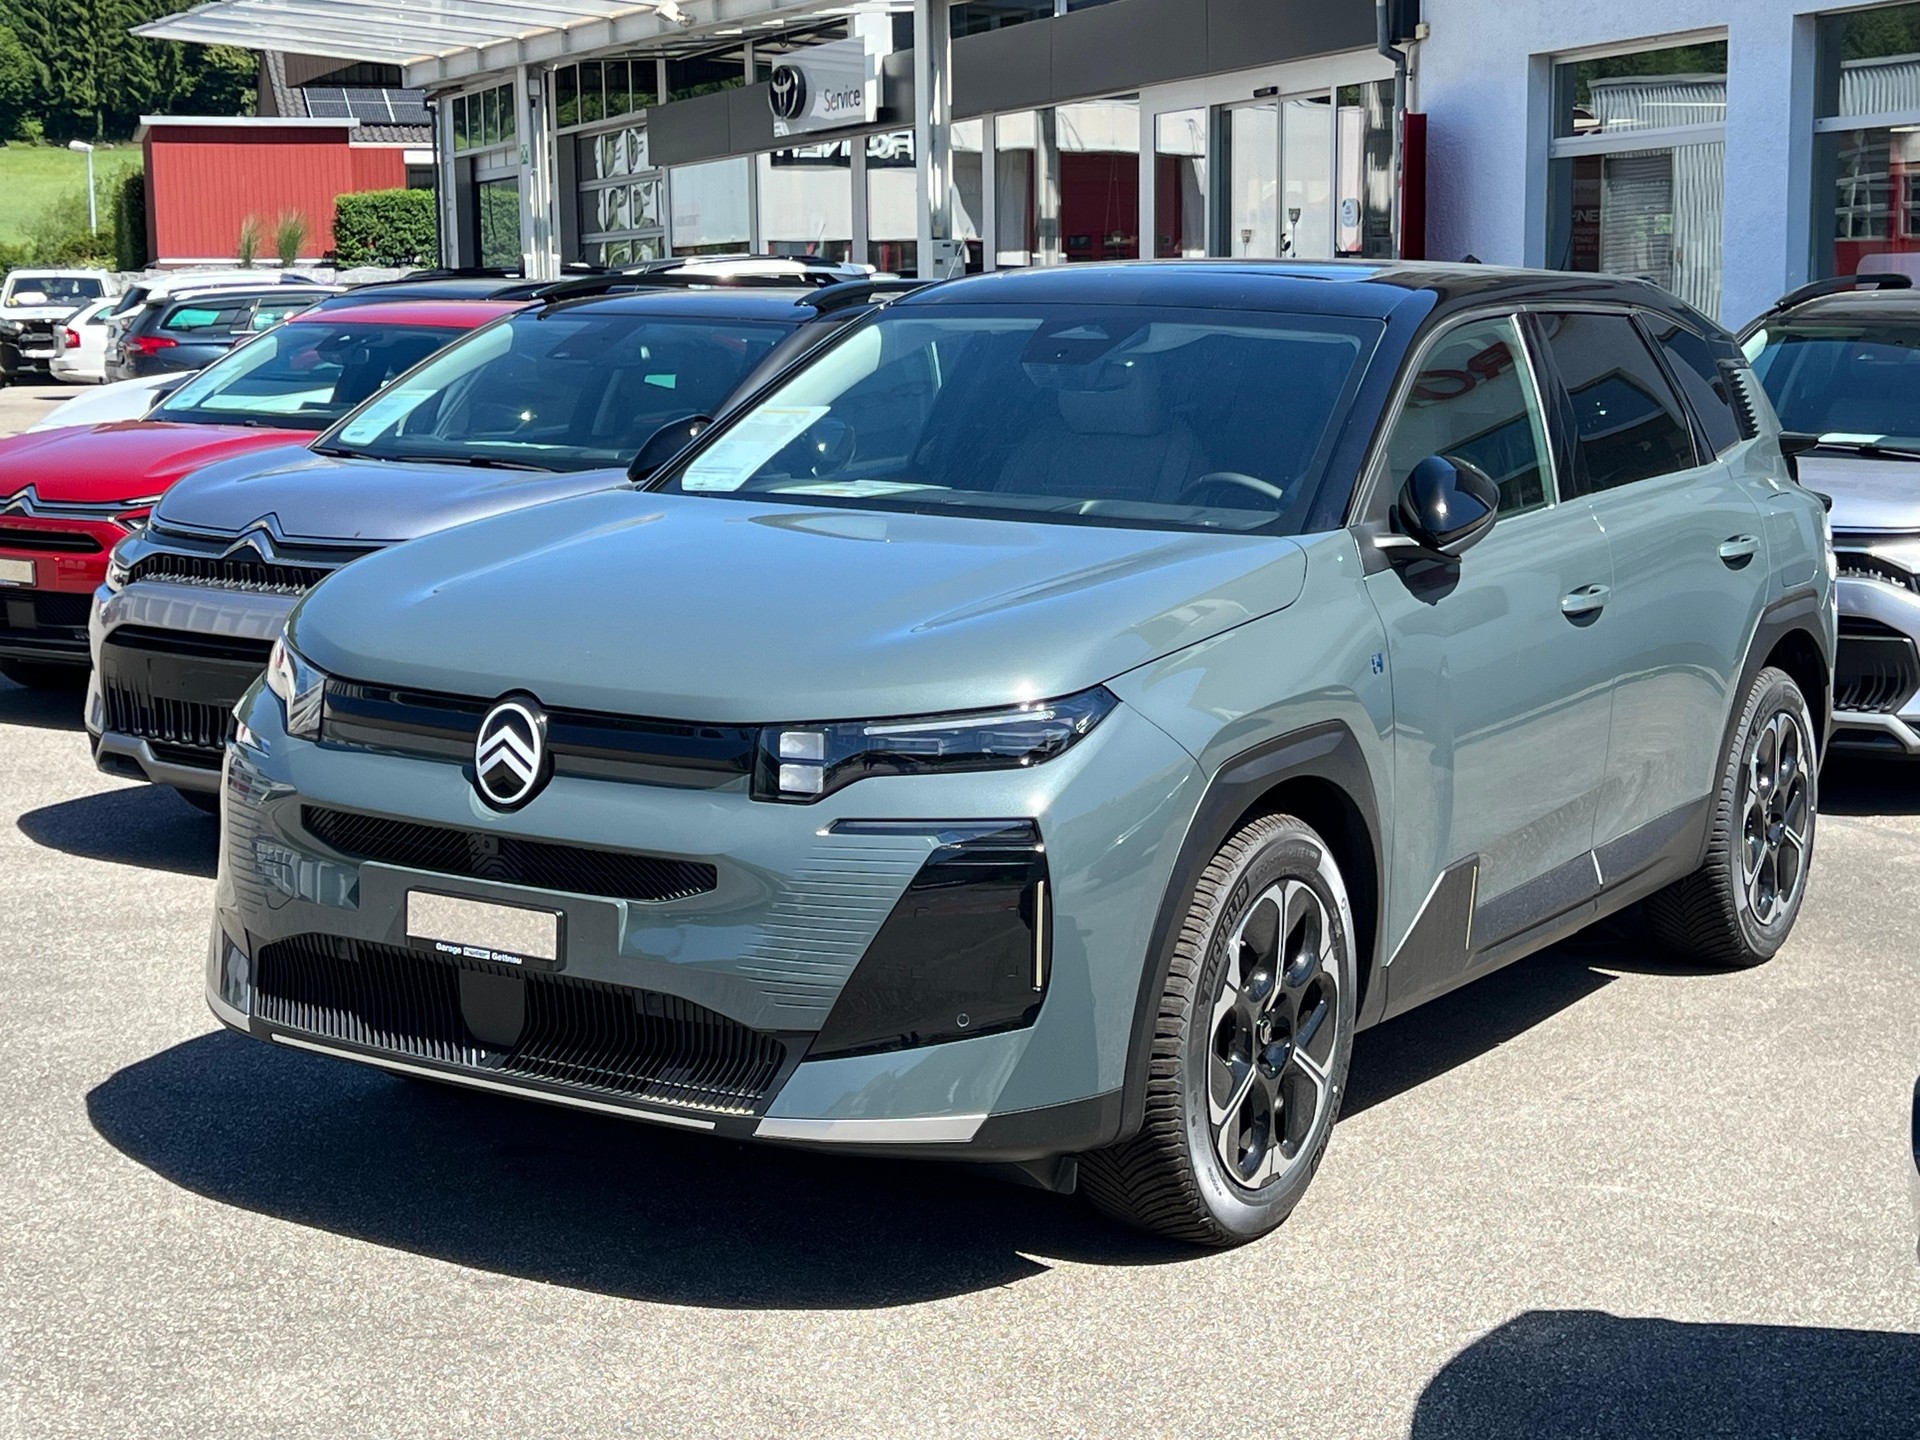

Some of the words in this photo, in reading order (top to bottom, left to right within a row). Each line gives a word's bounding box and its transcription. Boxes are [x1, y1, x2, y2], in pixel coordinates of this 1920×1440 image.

[824, 85, 861, 112] Service
[436, 942, 462, 955] Garage
[1203, 880, 1250, 997] MICHELIN
